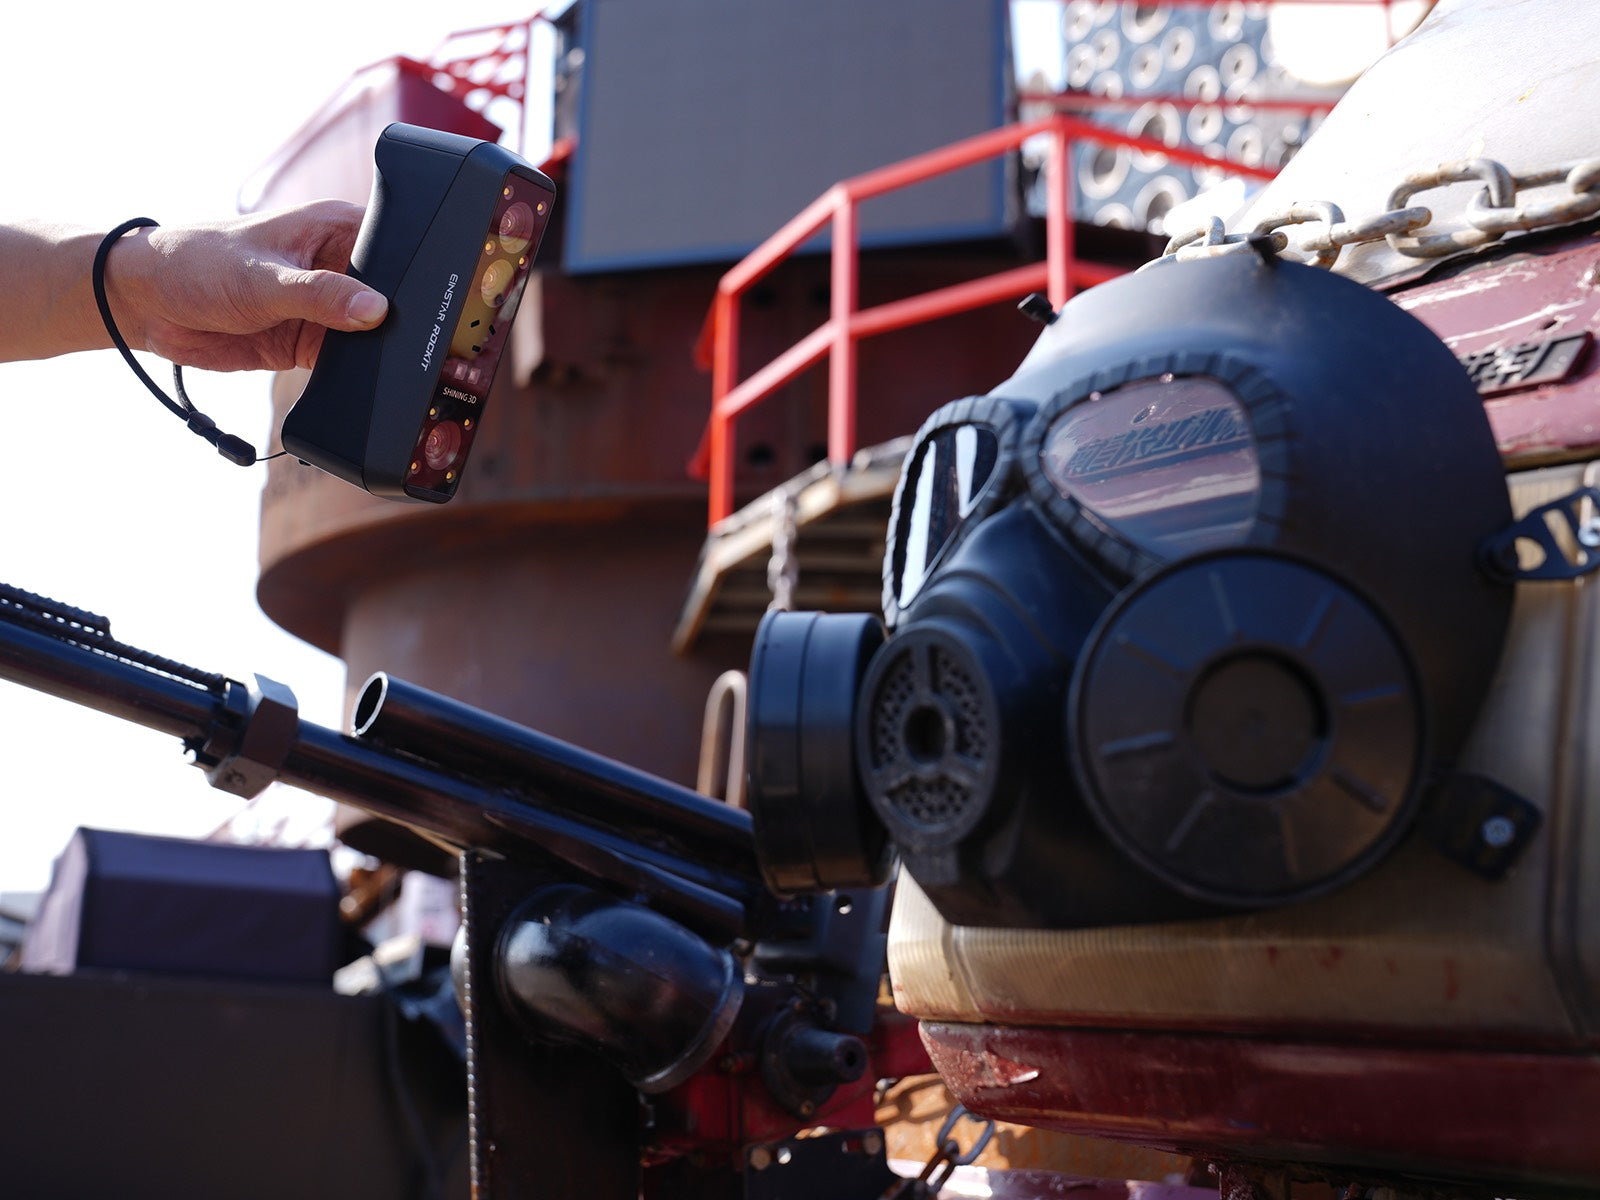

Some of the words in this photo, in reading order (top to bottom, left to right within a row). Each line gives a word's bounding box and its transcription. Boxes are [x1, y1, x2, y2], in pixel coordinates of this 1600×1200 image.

[437, 273, 458, 322] EINSTAR
[421, 324, 440, 371] ROCKIT
[442, 386, 468, 402] SHINING
[468, 393, 477, 404] 3D
